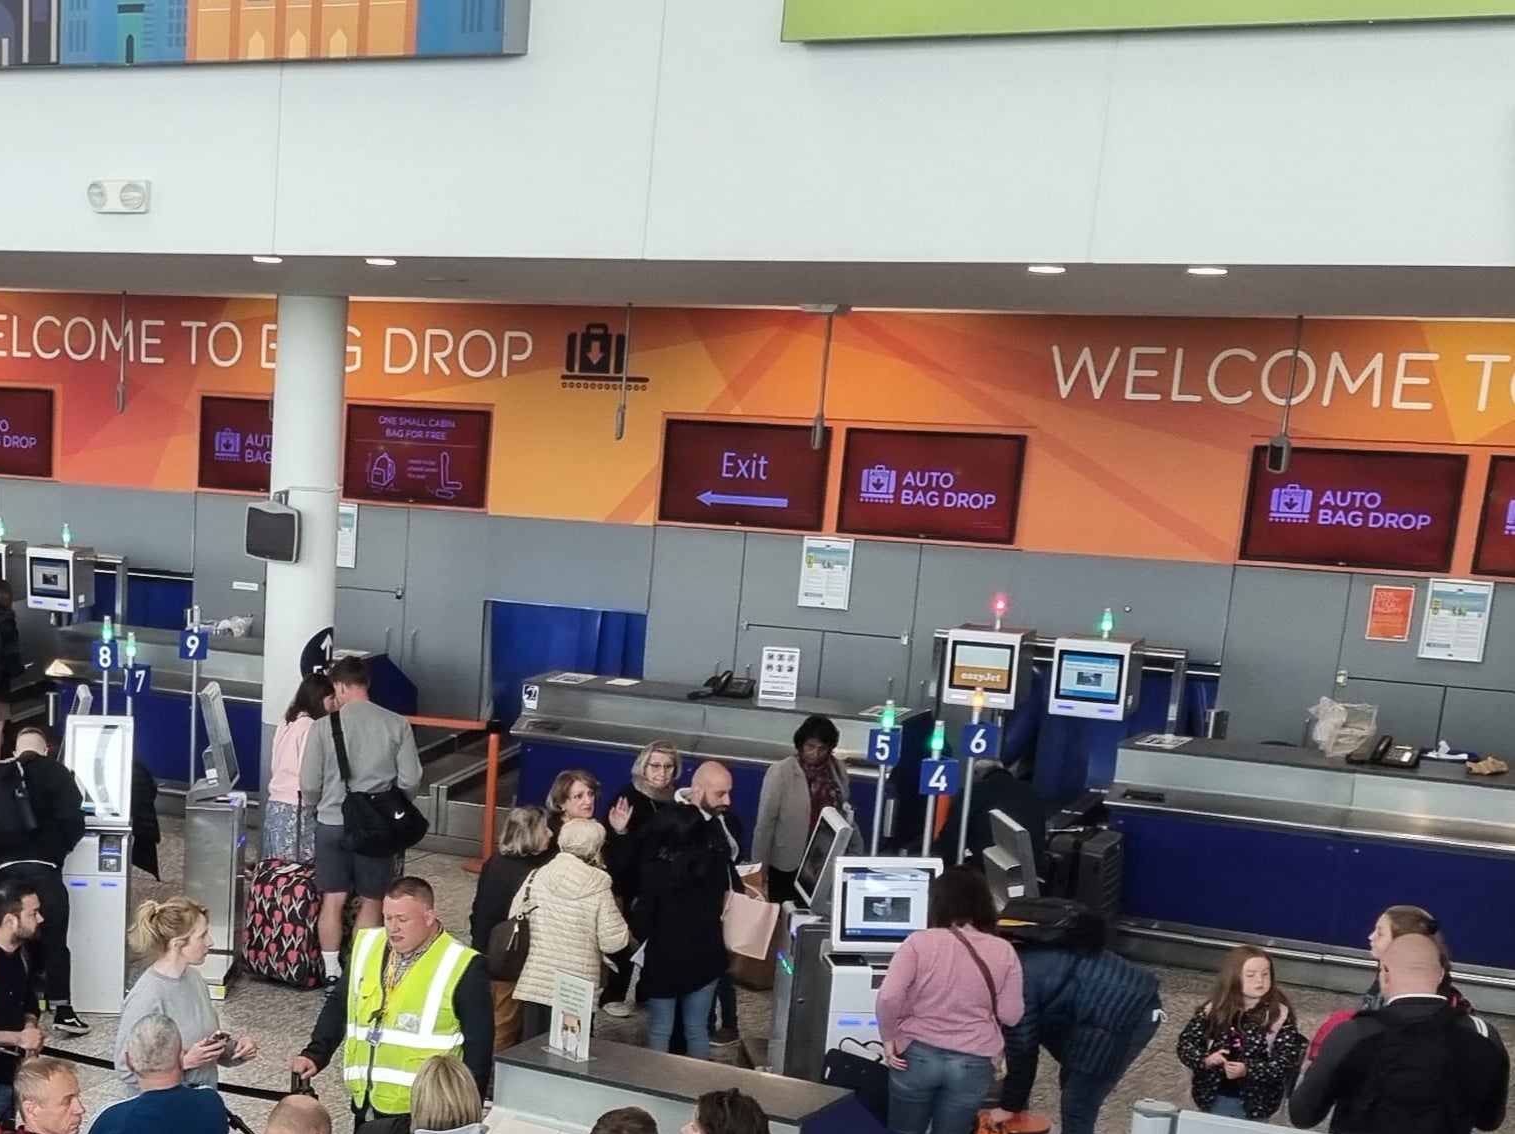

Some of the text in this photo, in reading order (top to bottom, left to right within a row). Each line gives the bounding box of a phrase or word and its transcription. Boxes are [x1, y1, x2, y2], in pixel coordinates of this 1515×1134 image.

[182, 320, 243, 367] TO
[385, 327, 533, 378] DROP
[1052, 345, 1515, 412] WELCOME T
[378, 415, 456, 428] ONE SMALL CABIN
[3, 436, 37, 449] DROP
[245, 433, 272, 446] AUT
[386, 429, 447, 440] BAG FOR FREE
[721, 451, 768, 480] Exit
[902, 471, 955, 489] AUTO
[900, 490, 996, 509] BAG DROP
[1318, 490, 1382, 509] AUTO
[1317, 509, 1432, 531] BAG DROP
[99, 645, 111, 668] 8
[186, 635, 199, 657] 9
[135, 670, 146, 693] 7
[961, 672, 1001, 683] easyJet
[875, 734, 890, 761] 5
[970, 728, 987, 754] 6
[928, 764, 948, 791] 4
